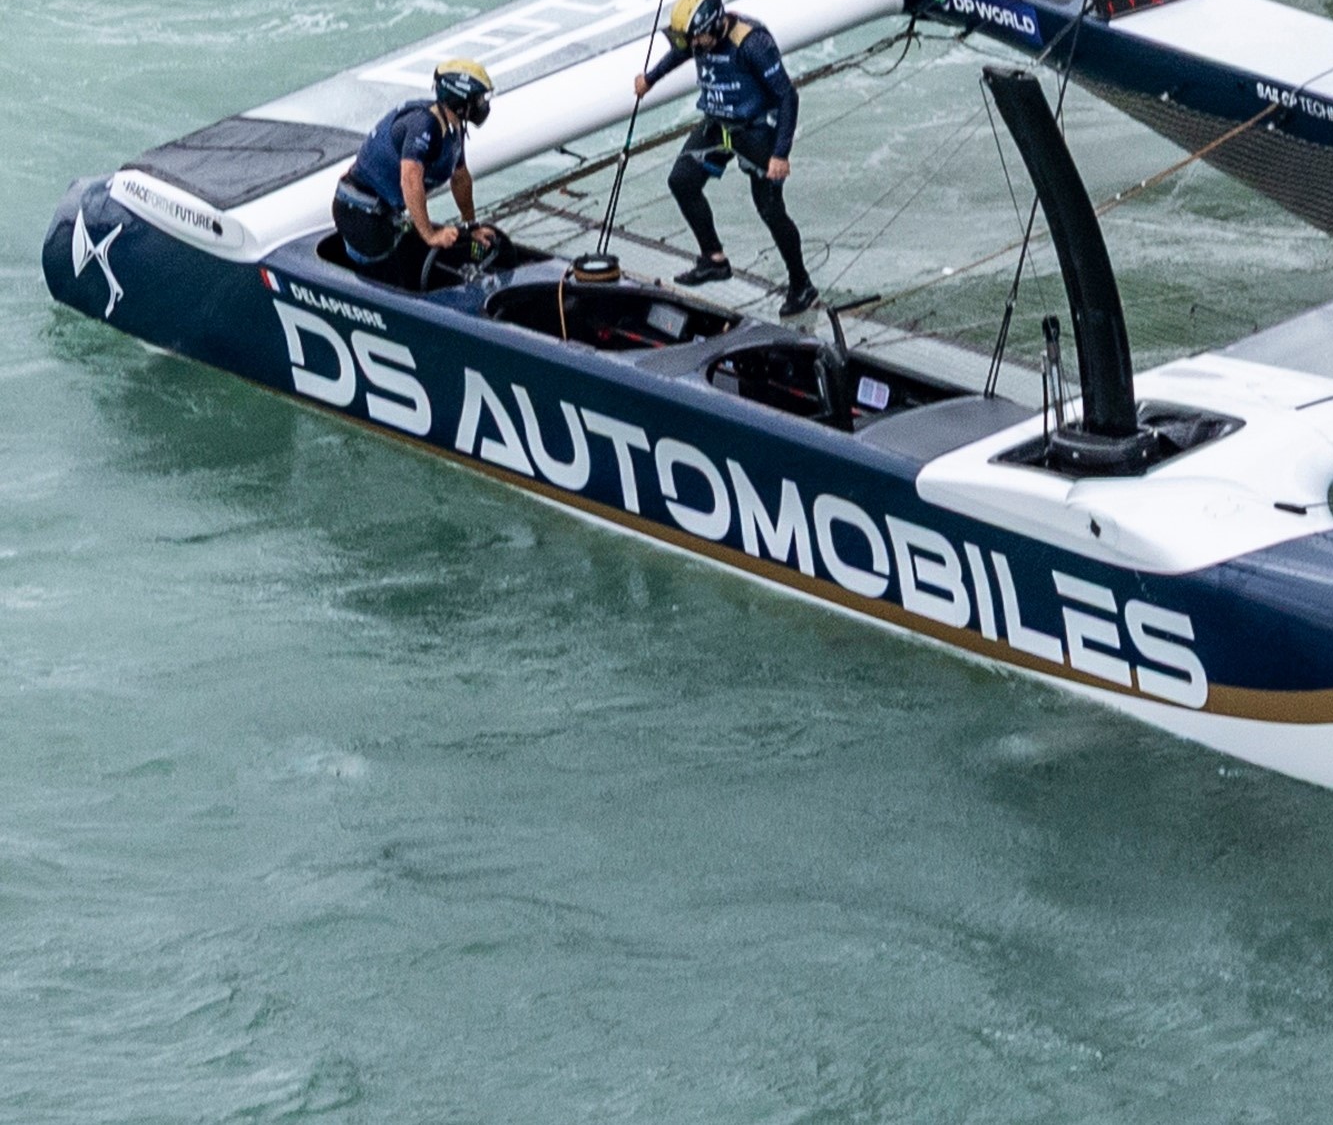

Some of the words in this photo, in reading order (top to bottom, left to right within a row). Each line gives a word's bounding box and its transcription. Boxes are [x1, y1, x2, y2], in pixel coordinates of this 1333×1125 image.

[975, 0, 1037, 35] WORLD
[289, 282, 387, 331] DELAPIERRE
[273, 298, 433, 437] DS
[454, 366, 1209, 710] AUTOMOBILES
